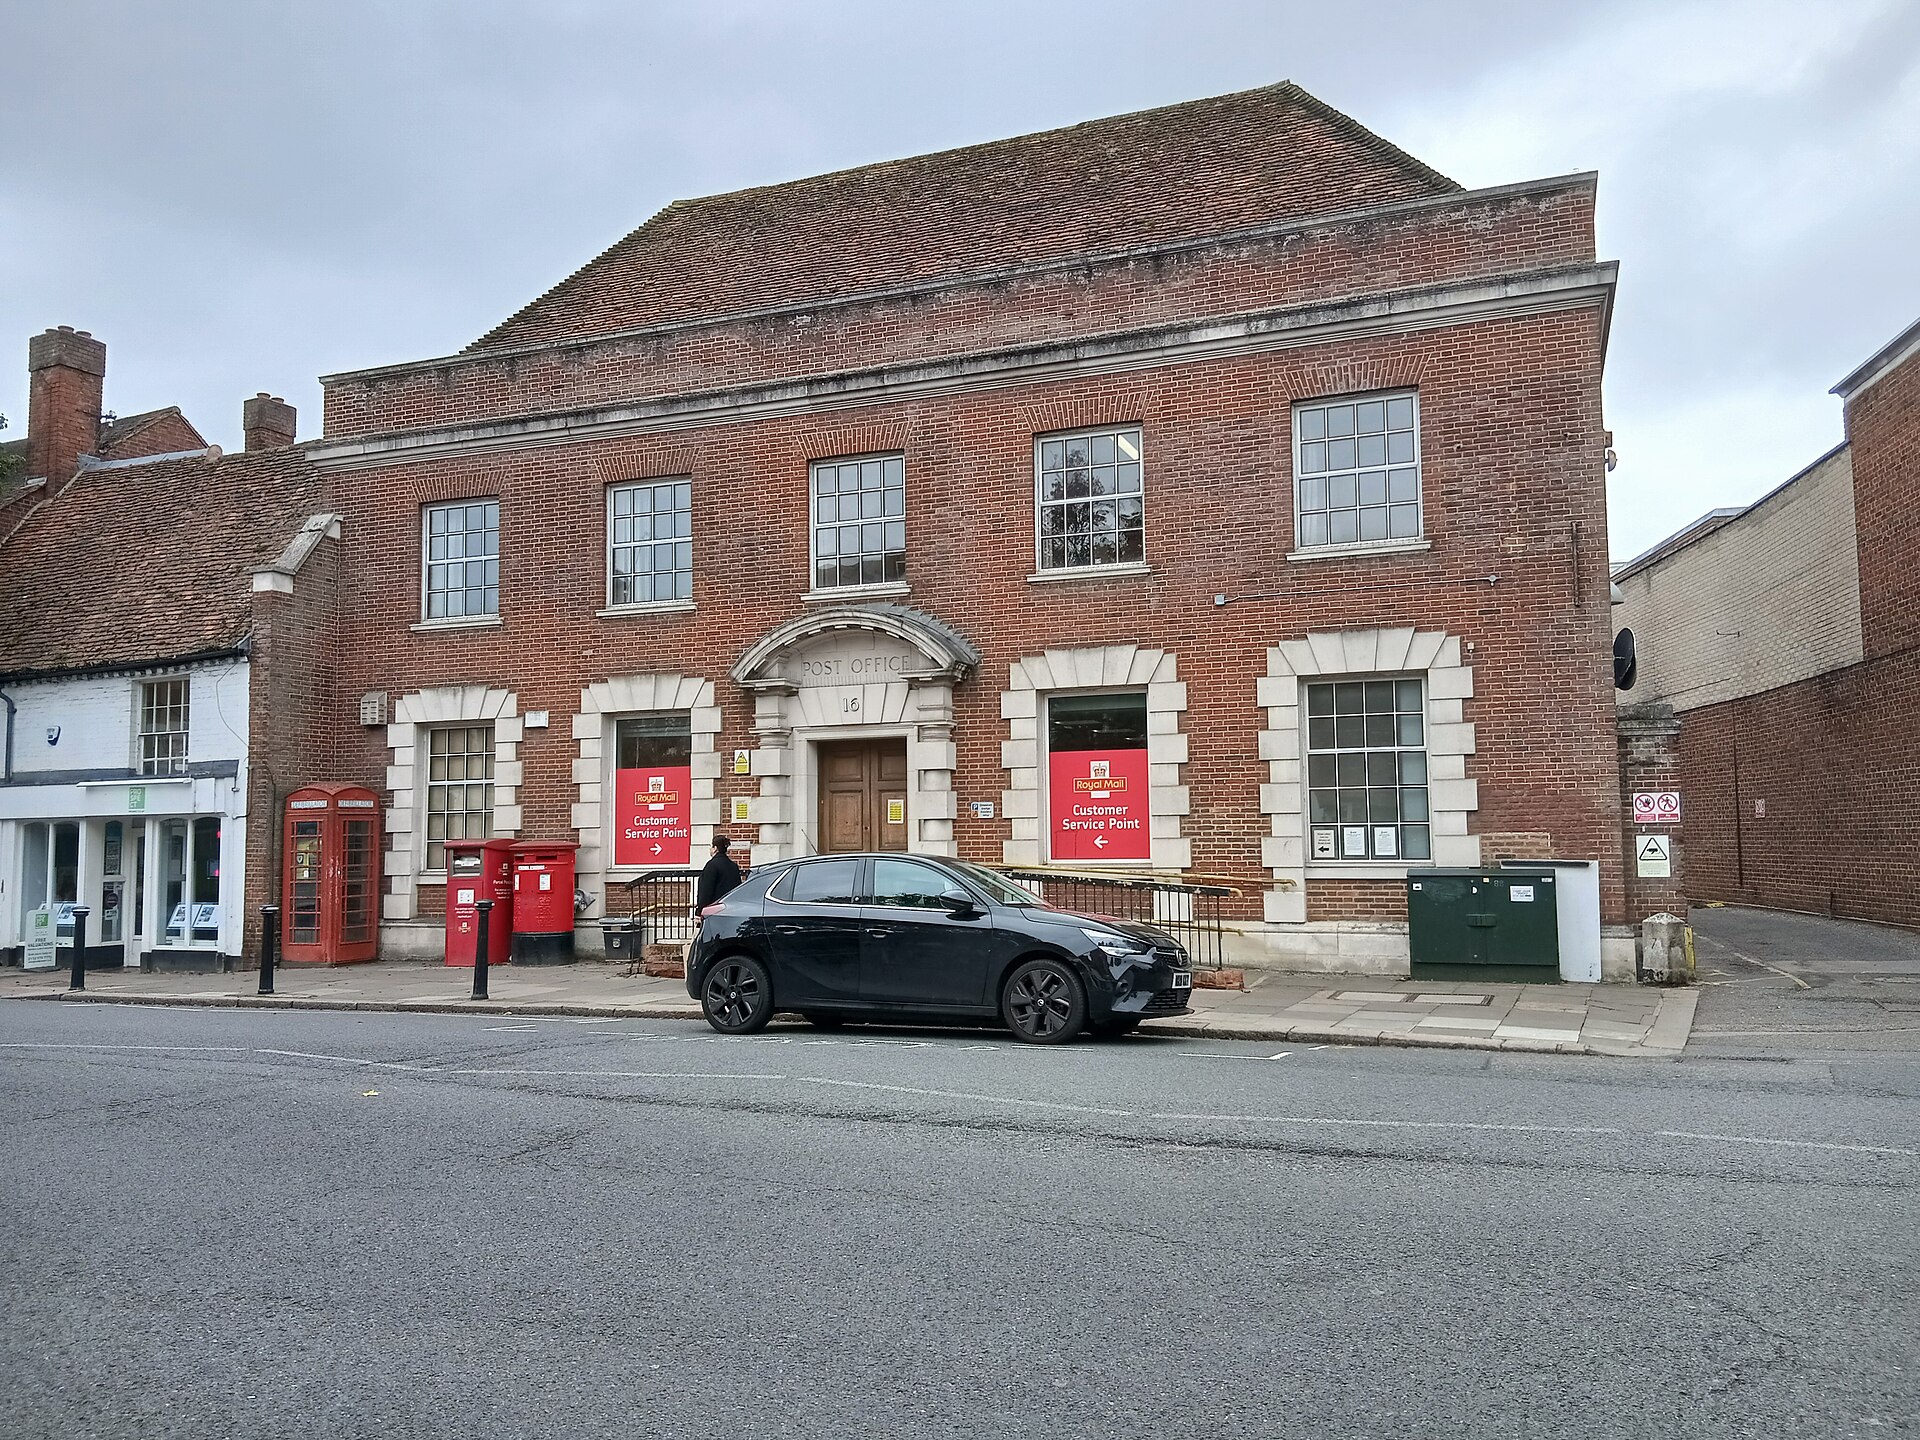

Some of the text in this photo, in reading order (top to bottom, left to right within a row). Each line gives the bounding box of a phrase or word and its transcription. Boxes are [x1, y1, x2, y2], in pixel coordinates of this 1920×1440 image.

[803, 655, 910, 676] POST OFFICE
[843, 697, 860, 712] 16
[1076, 779, 1124, 791] Royal Mail
[637, 793, 676, 803] Royal Mail
[1073, 804, 1128, 816] Customer
[633, 815, 679, 826] Customer
[1062, 817, 1140, 830] Service Point
[625, 827, 688, 839] Service Point
